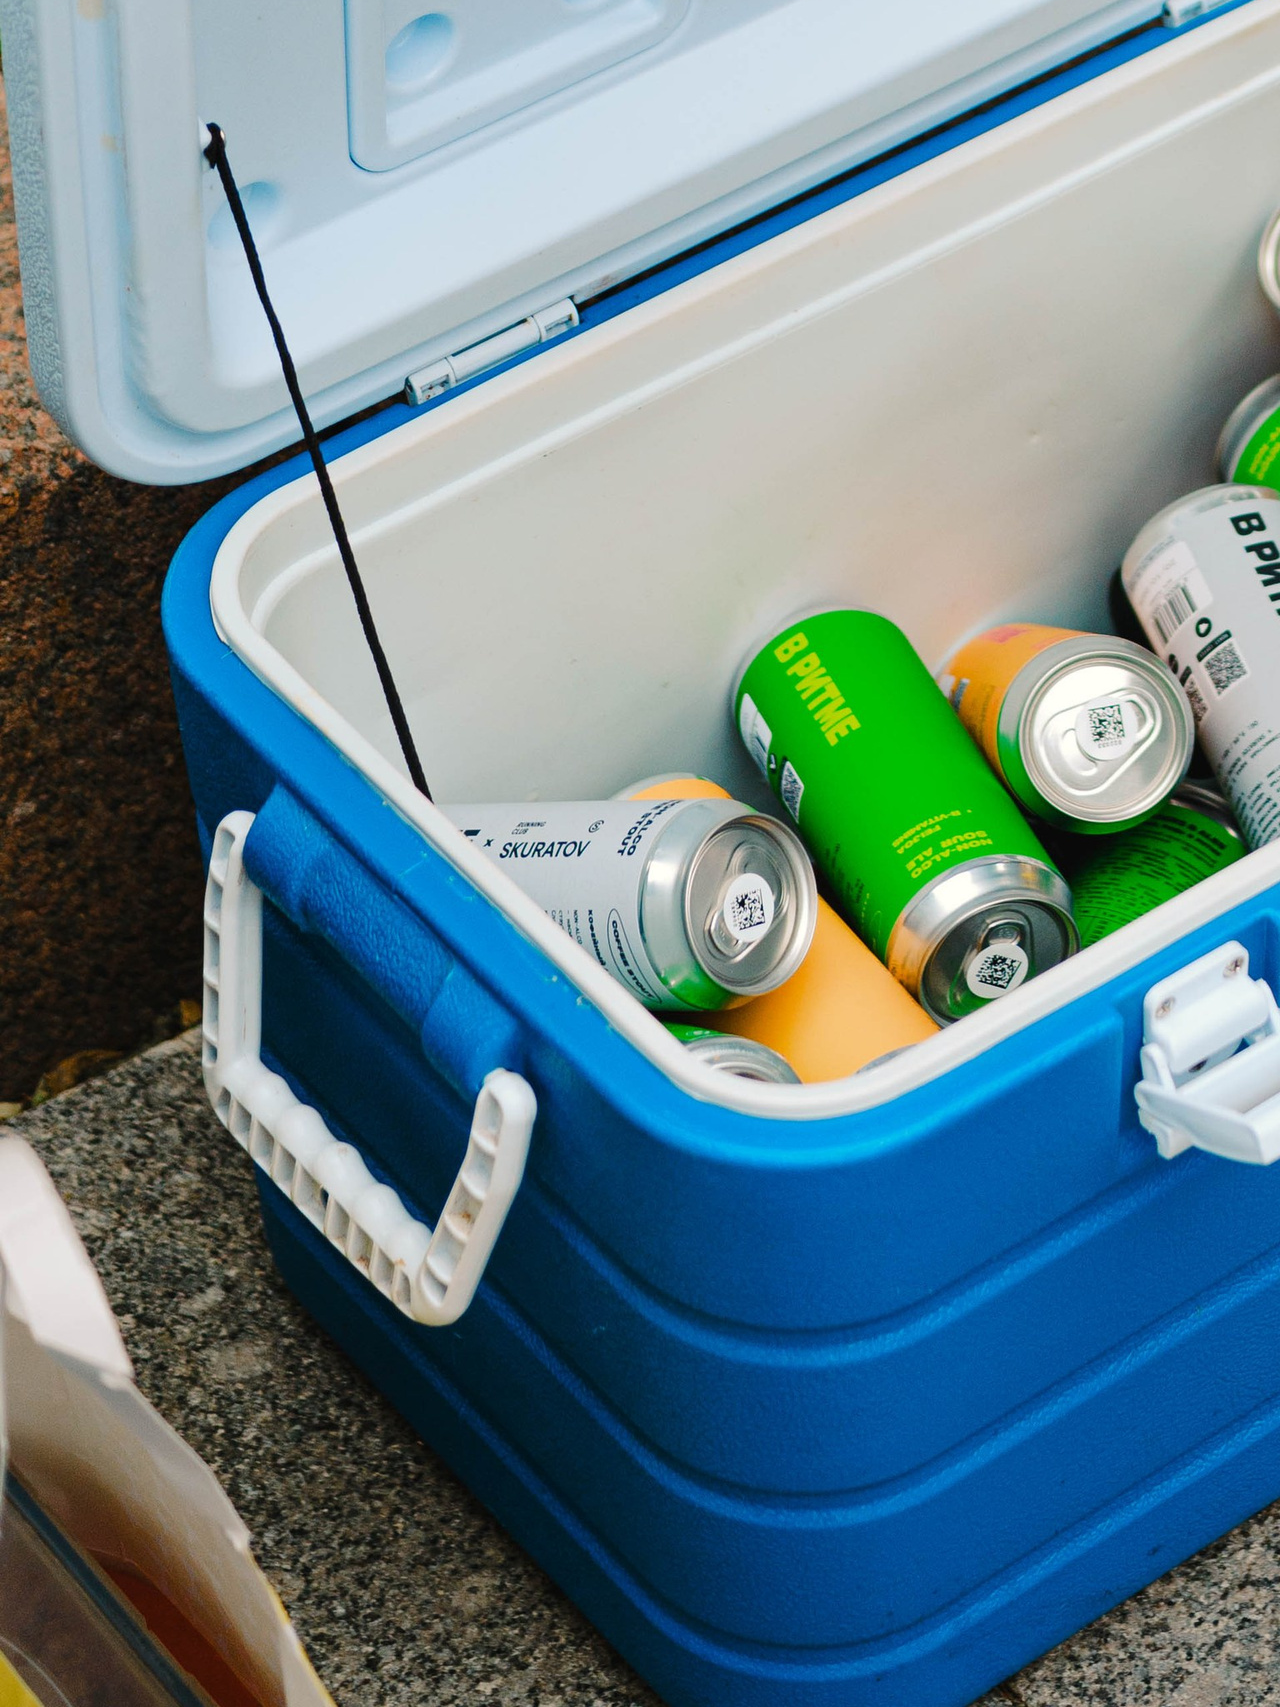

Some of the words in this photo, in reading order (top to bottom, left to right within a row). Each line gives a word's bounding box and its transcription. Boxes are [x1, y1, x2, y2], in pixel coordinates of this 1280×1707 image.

[786, 652, 862, 747] РИТМЕ
[499, 841, 591, 858] SKURATOV
[897, 824, 942, 854] FEIJOA
[940, 830, 988, 849] SOUR
[905, 847, 933, 871] ALE
[911, 838, 993, 879] NON-ALCO
[573, 910, 583, 944] NON-ALCO
[611, 919, 631, 968] COFFEE
